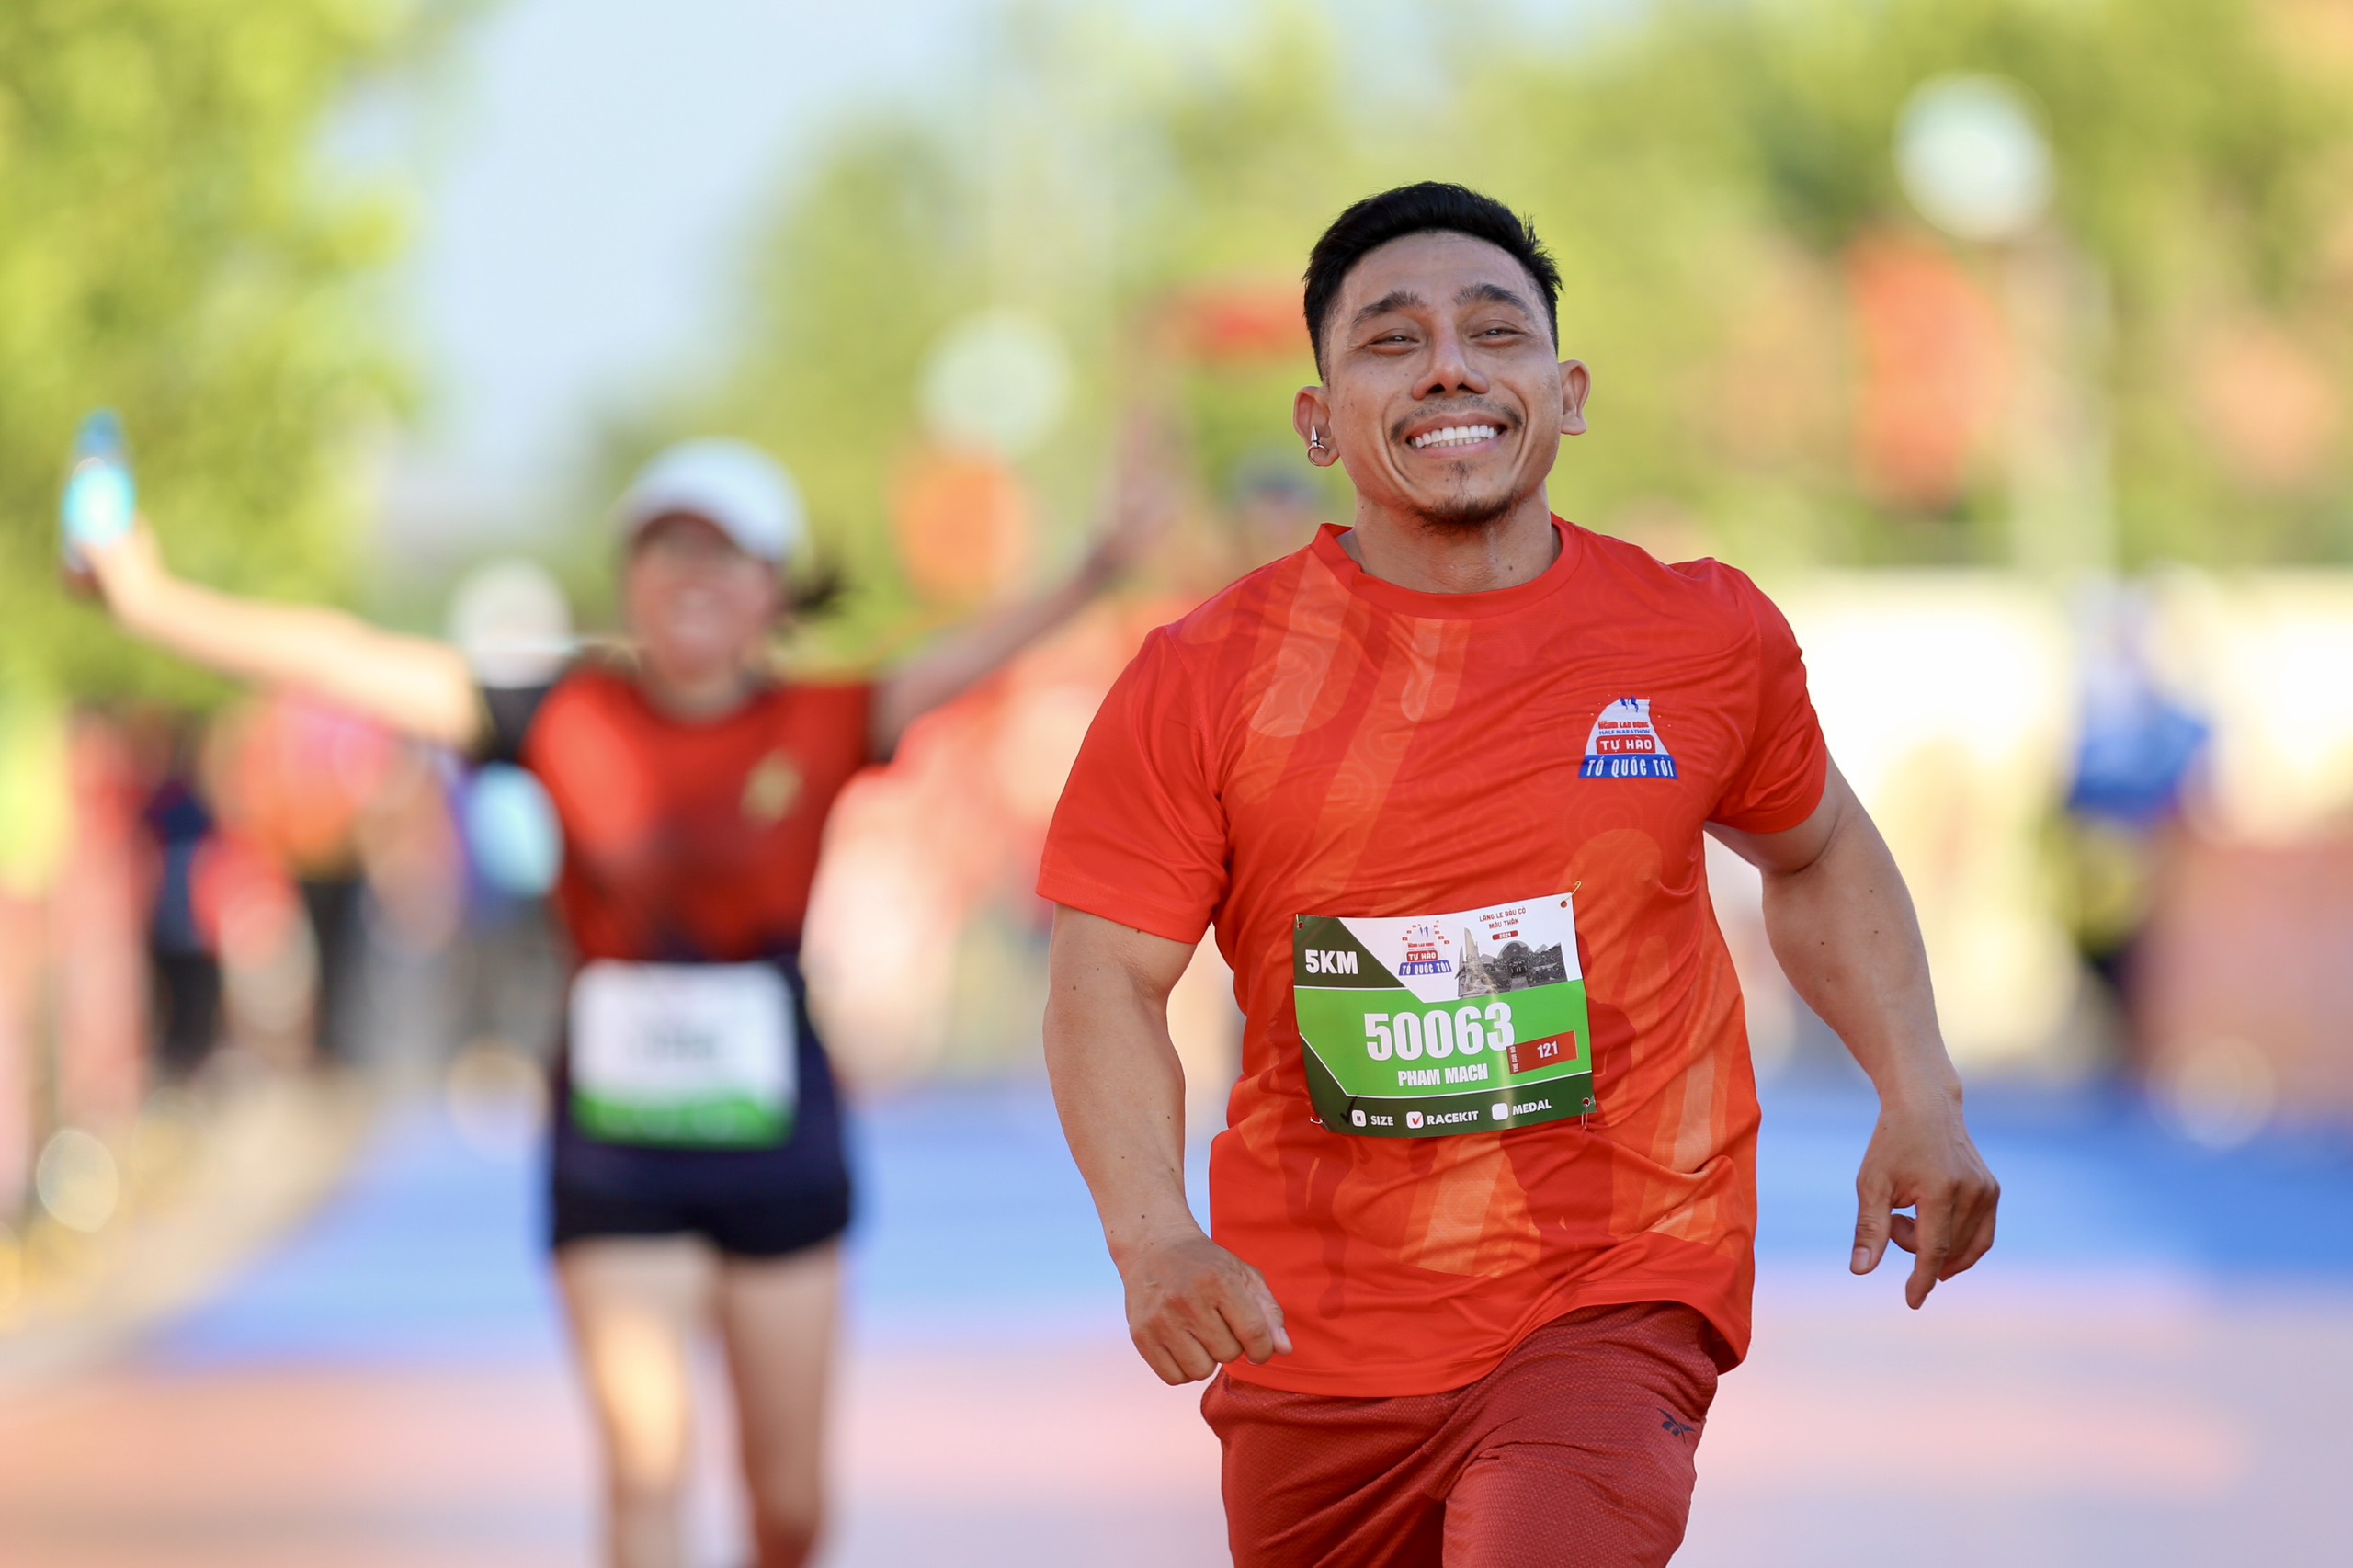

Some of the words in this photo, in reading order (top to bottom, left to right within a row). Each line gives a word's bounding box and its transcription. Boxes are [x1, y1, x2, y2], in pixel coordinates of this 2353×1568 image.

[1611, 756, 1647, 778] QUỐC
[1305, 949, 1358, 974] 5KM
[1364, 1002, 1515, 1061] 50063
[1537, 1040, 1559, 1059] 121
[1398, 1069, 1441, 1086] PHAM
[1445, 1063, 1488, 1084] MACH
[1512, 1099, 1552, 1116] MEDAL
[1370, 1115, 1394, 1126] SIZE
[1427, 1110, 1479, 1126] RACEKIT
